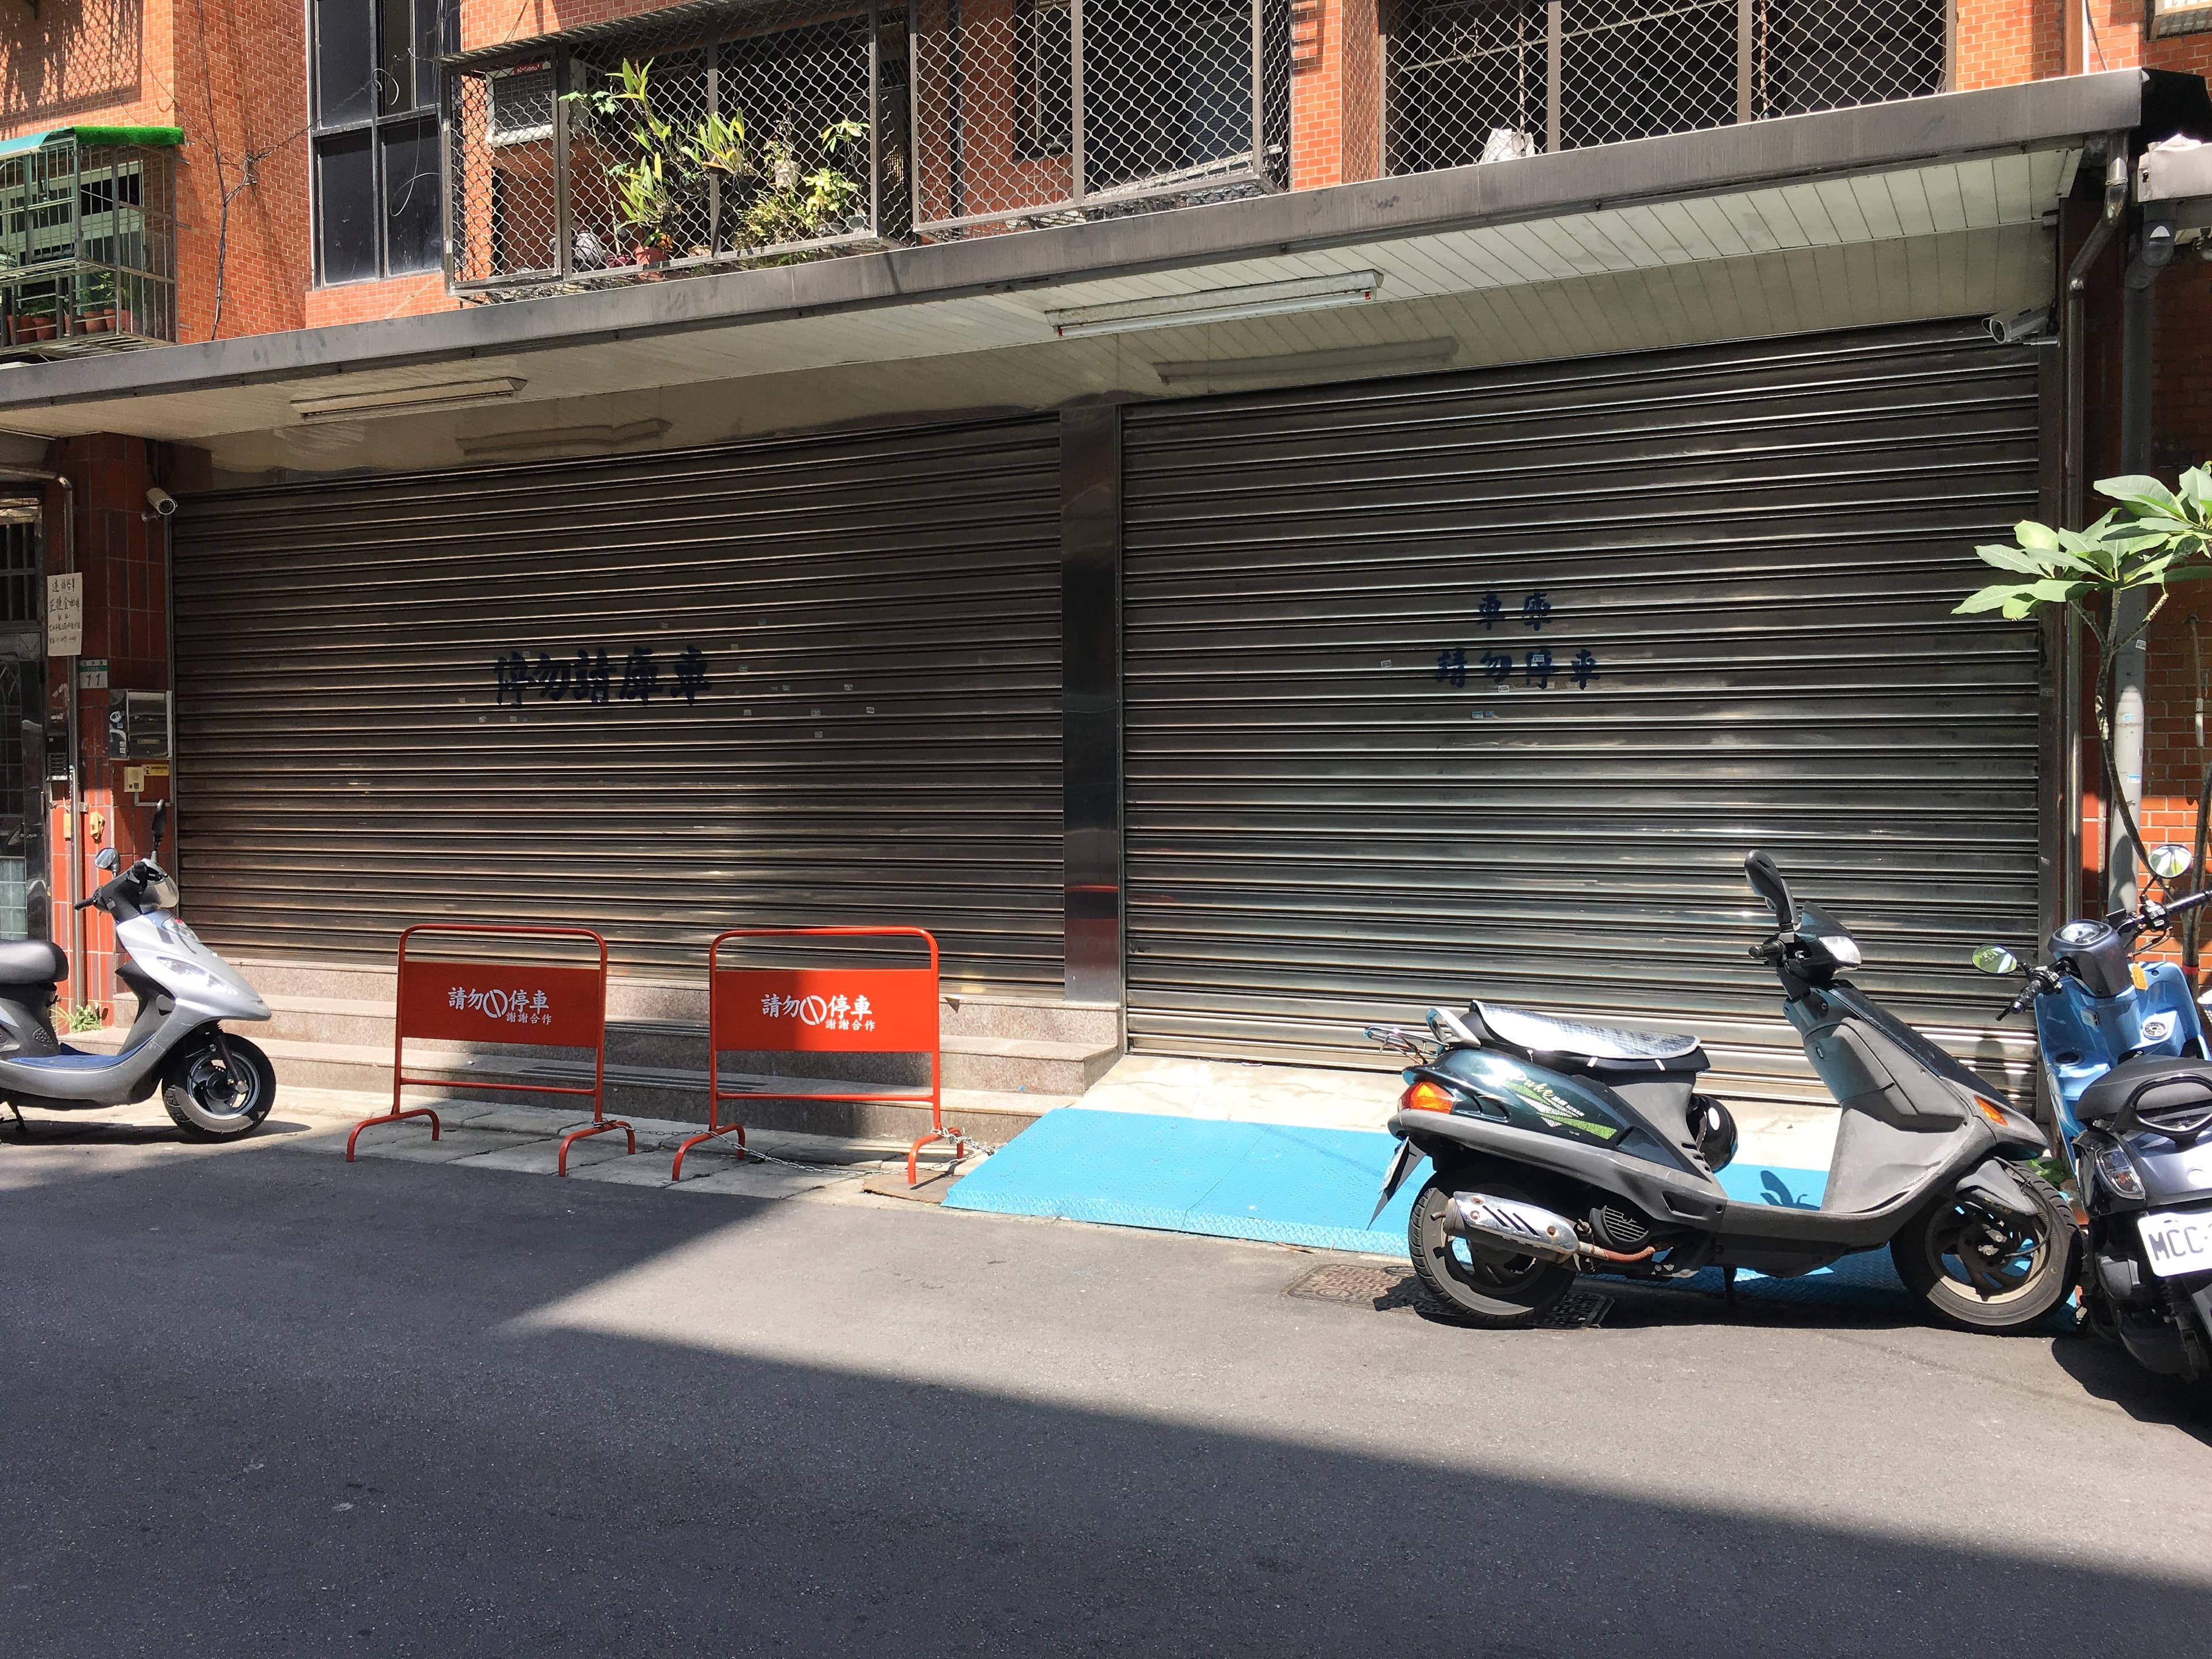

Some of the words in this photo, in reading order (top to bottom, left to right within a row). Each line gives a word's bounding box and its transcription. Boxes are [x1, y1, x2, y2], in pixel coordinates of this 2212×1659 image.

[1476, 591, 1552, 631] 車庫
[1434, 647, 1600, 690] 請勿停車
[87, 673, 100, 687] 11
[506, 1012, 552, 1025] 謝謝合作
[825, 1019, 876, 1032] 謝謝合作
